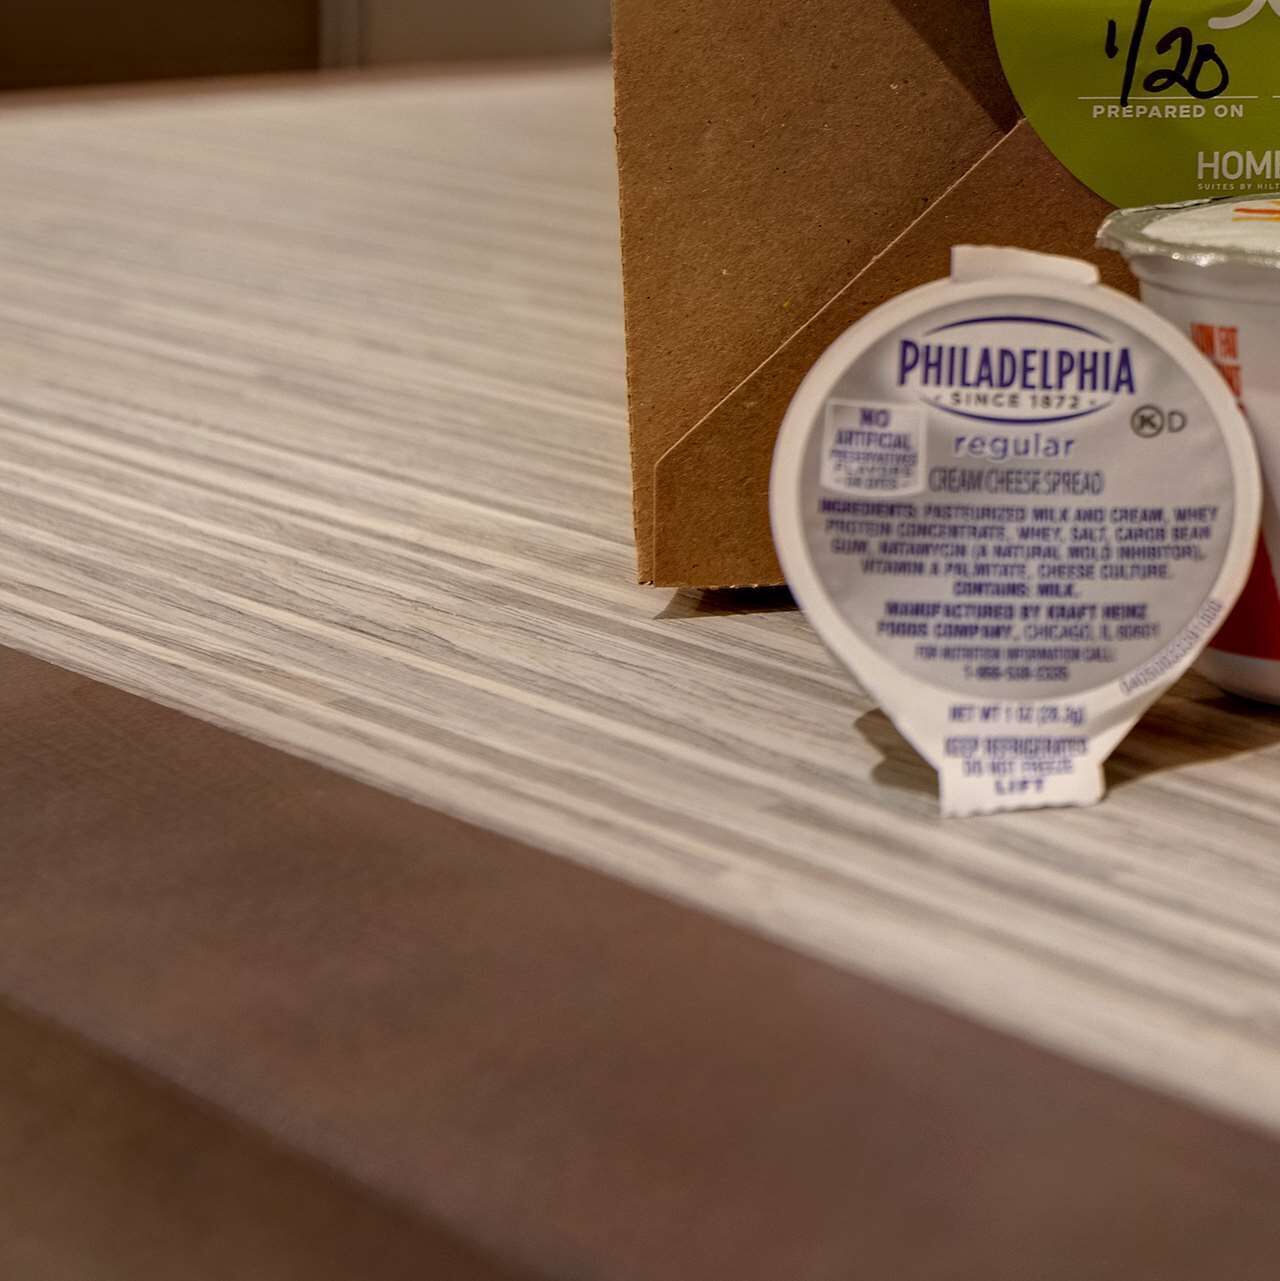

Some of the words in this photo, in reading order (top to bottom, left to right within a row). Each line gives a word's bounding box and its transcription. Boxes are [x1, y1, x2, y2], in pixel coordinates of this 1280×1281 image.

[1092, 104, 1205, 119] PREPARED
[1213, 104, 1244, 118] ON
[897, 339, 1136, 396] PHILADELPHIA
[951, 391, 1020, 408] SINCE
[1030, 393, 1081, 409] 1872
[859, 407, 892, 428] NO
[836, 429, 912, 451] ARTIFICIAL
[954, 433, 1075, 461] regular
[928, 467, 984, 493] CREAM
[985, 468, 1042, 495] CHEESE
[1045, 469, 1105, 496] SPREAD
[923, 504, 1025, 523] PASTEURIZED
[1032, 506, 1069, 522] MILK
[1075, 506, 1105, 522] AND
[1173, 505, 1219, 522] WHEY
[825, 518, 892, 538] PROTEIN
[1171, 524, 1212, 542] BEAN
[1037, 563, 1096, 580] CHEESE
[885, 600, 1015, 621] MANUFACTURED
[1020, 603, 1042, 621] BY
[1046, 603, 1097, 621] KRAFT
[1101, 603, 1148, 621] HEINZ
[878, 620, 929, 639] FOODS
[949, 704, 975, 723] NET
[979, 704, 1001, 723] WT
[994, 777, 1045, 796] LIFT
